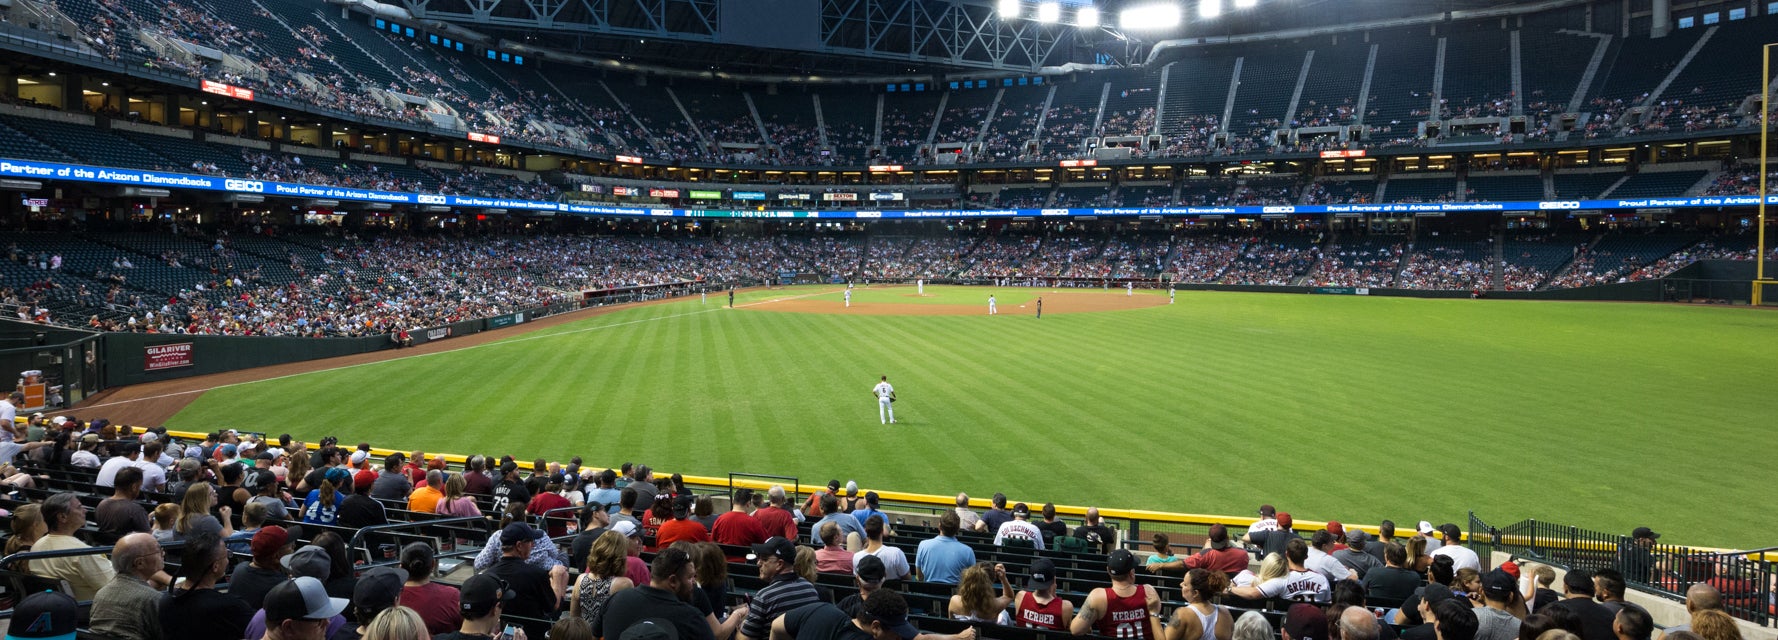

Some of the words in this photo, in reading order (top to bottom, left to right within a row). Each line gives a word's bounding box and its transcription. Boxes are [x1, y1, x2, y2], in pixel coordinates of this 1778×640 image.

[1, 162, 54, 175] Partner
[57, 164, 71, 176] of
[74, 166, 95, 178] the
[98, 169, 140, 182] Arizona
[143, 173, 211, 187] Diamondbacks
[225, 179, 264, 192] GEICO
[276, 184, 298, 194] Proud
[300, 187, 325, 196] Partner
[327, 188, 334, 196] of
[334, 189, 345, 197] the
[346, 190, 368, 199] Arizona
[368, 192, 408, 201] Diamondbacks
[417, 194, 446, 204] GEICO
[456, 197, 472, 205] Proud
[473, 198, 493, 206] Partner
[1539, 201, 1580, 209] GEICO
[492, 495, 510, 512] 79
[1287, 580, 1322, 594] GREINKE
[1023, 608, 1055, 625] KERBER
[1112, 608, 1146, 621] KERBER
